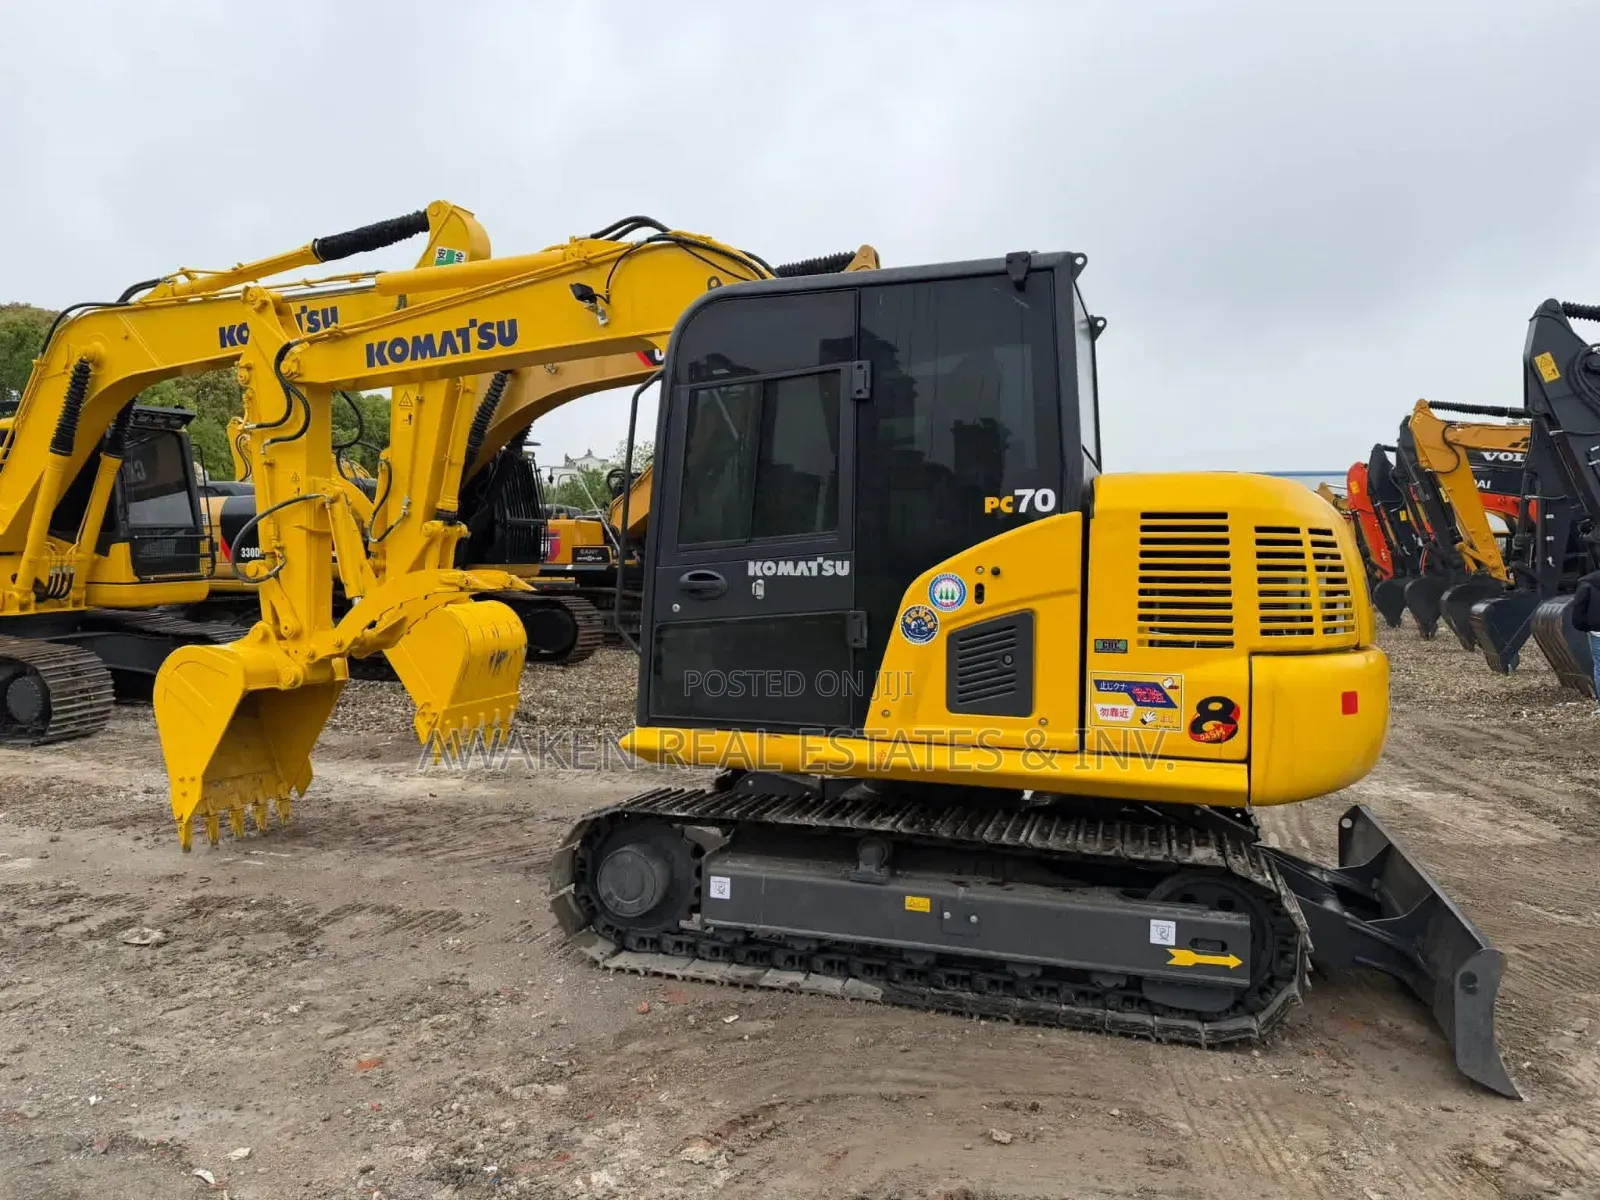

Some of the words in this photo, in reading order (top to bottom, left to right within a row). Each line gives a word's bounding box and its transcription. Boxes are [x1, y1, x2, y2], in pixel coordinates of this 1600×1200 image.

[365, 318, 518, 368] KOMATSU
[984, 488, 1056, 513] PC70
[240, 547, 260, 558] 330D
[747, 557, 850, 576] KOMATSU
